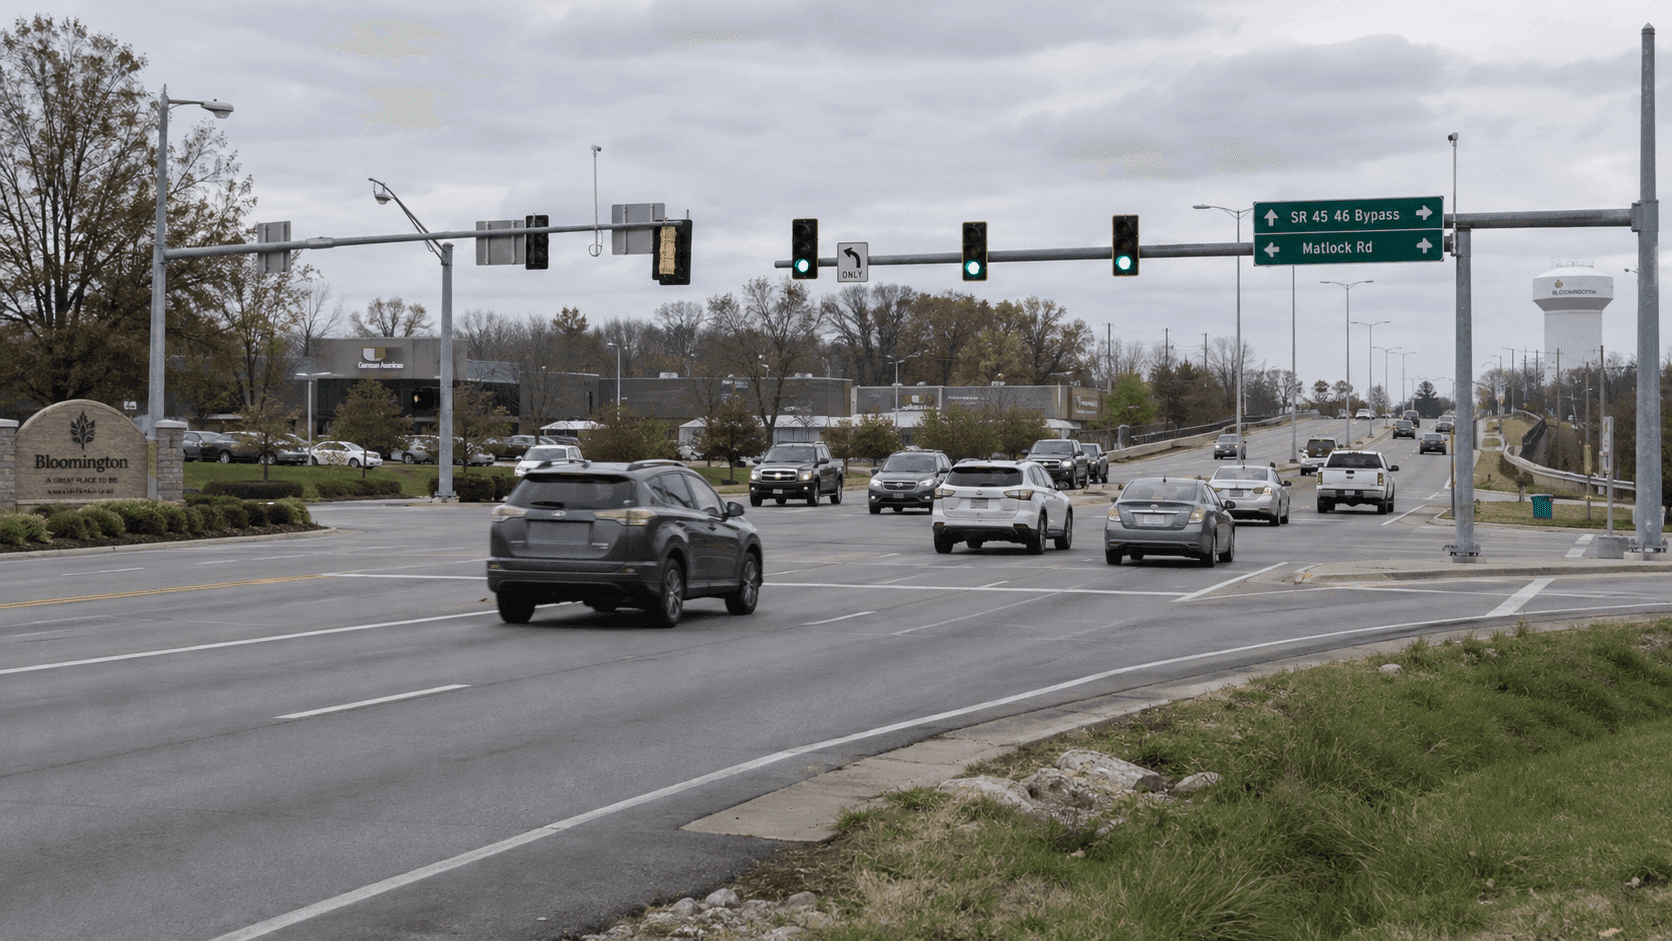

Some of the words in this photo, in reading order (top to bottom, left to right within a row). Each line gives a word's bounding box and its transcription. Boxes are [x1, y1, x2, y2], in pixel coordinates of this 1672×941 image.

[1291, 211, 1307, 223] SR
[1312, 210, 1328, 223] 45
[1334, 209, 1350, 222] 46
[1355, 208, 1400, 224] Bypass
[1302, 241, 1352, 255] Matlock
[1356, 240, 1373, 253] Rd
[842, 270, 863, 279] ONLY
[34, 454, 129, 473] Bloomington
